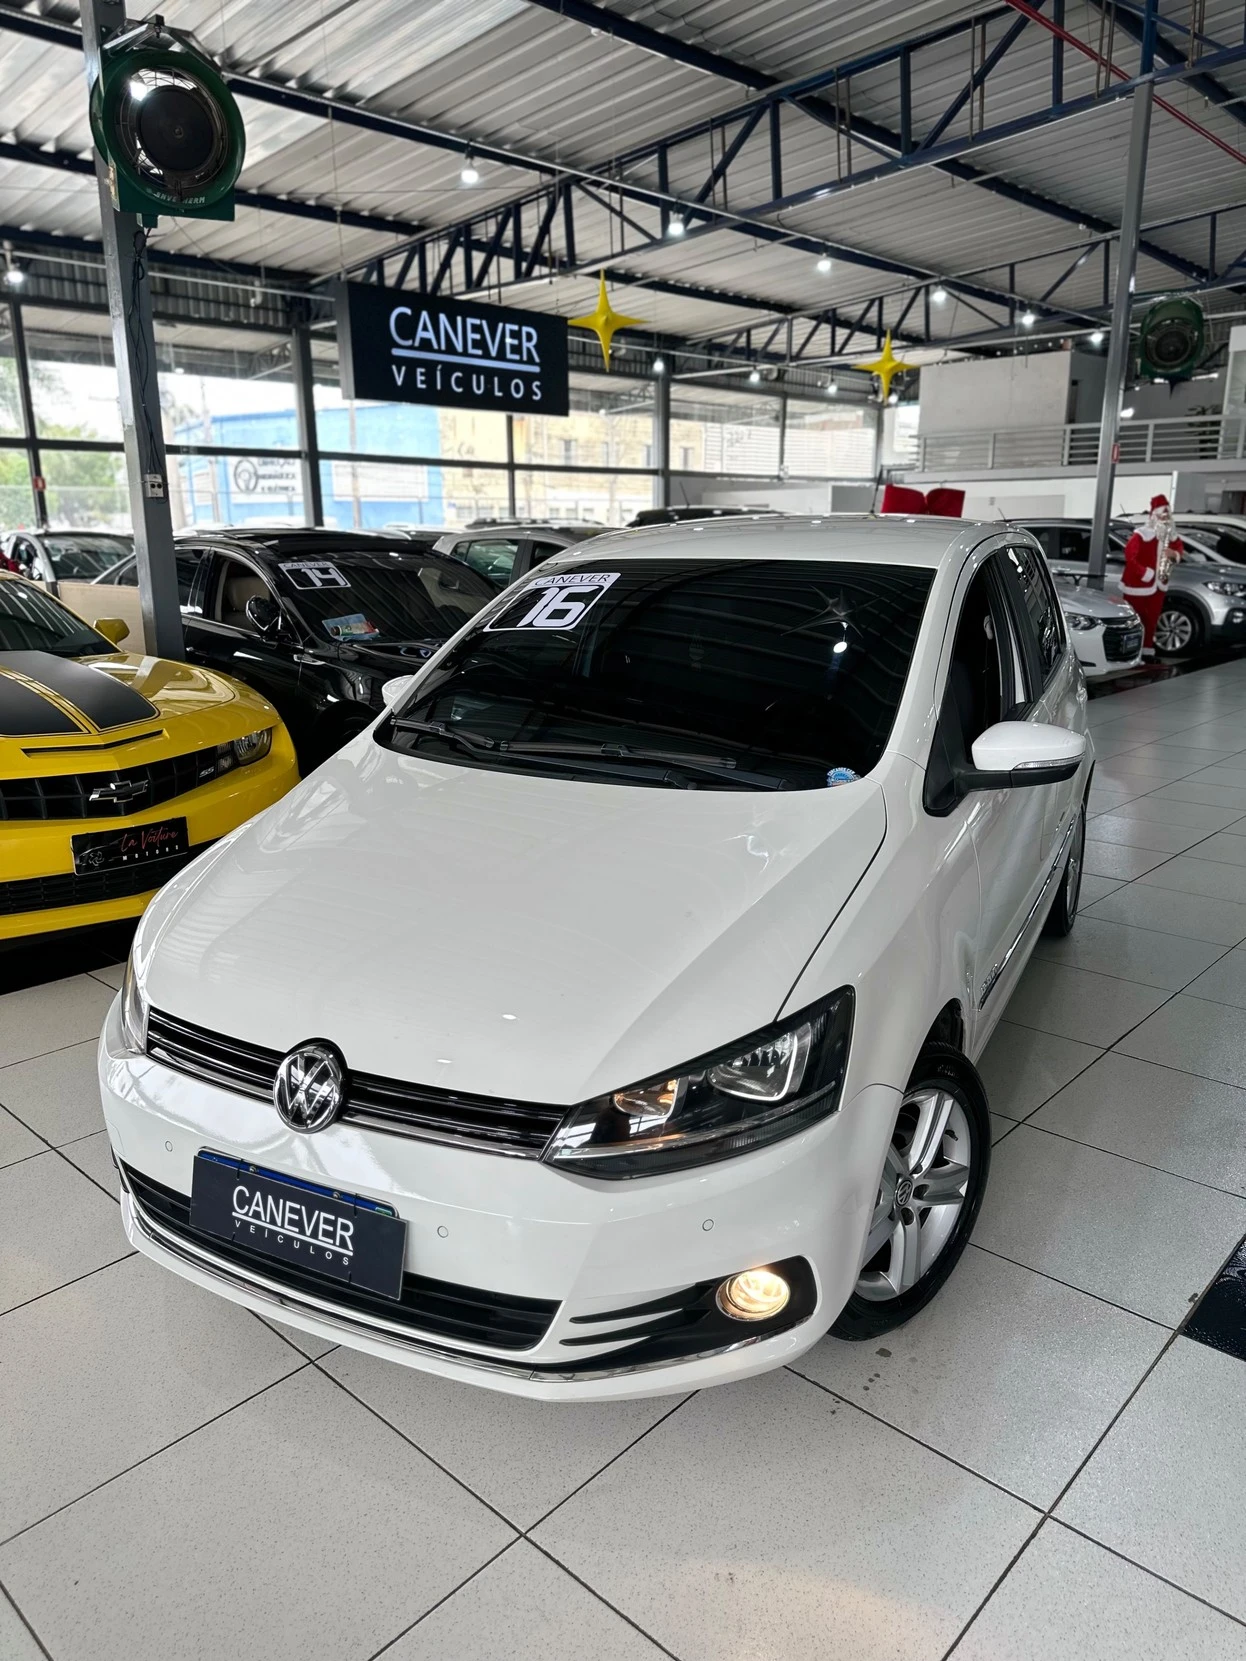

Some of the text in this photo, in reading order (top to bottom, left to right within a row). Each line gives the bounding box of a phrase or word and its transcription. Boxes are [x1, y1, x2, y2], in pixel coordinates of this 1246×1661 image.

[389, 306, 540, 363] CANEVER
[391, 364, 542, 400] VEÍCULOS
[301, 568, 347, 587] 14
[534, 574, 611, 586] CANEVER
[516, 586, 599, 627] 16
[232, 1185, 354, 1251] CANEVER
